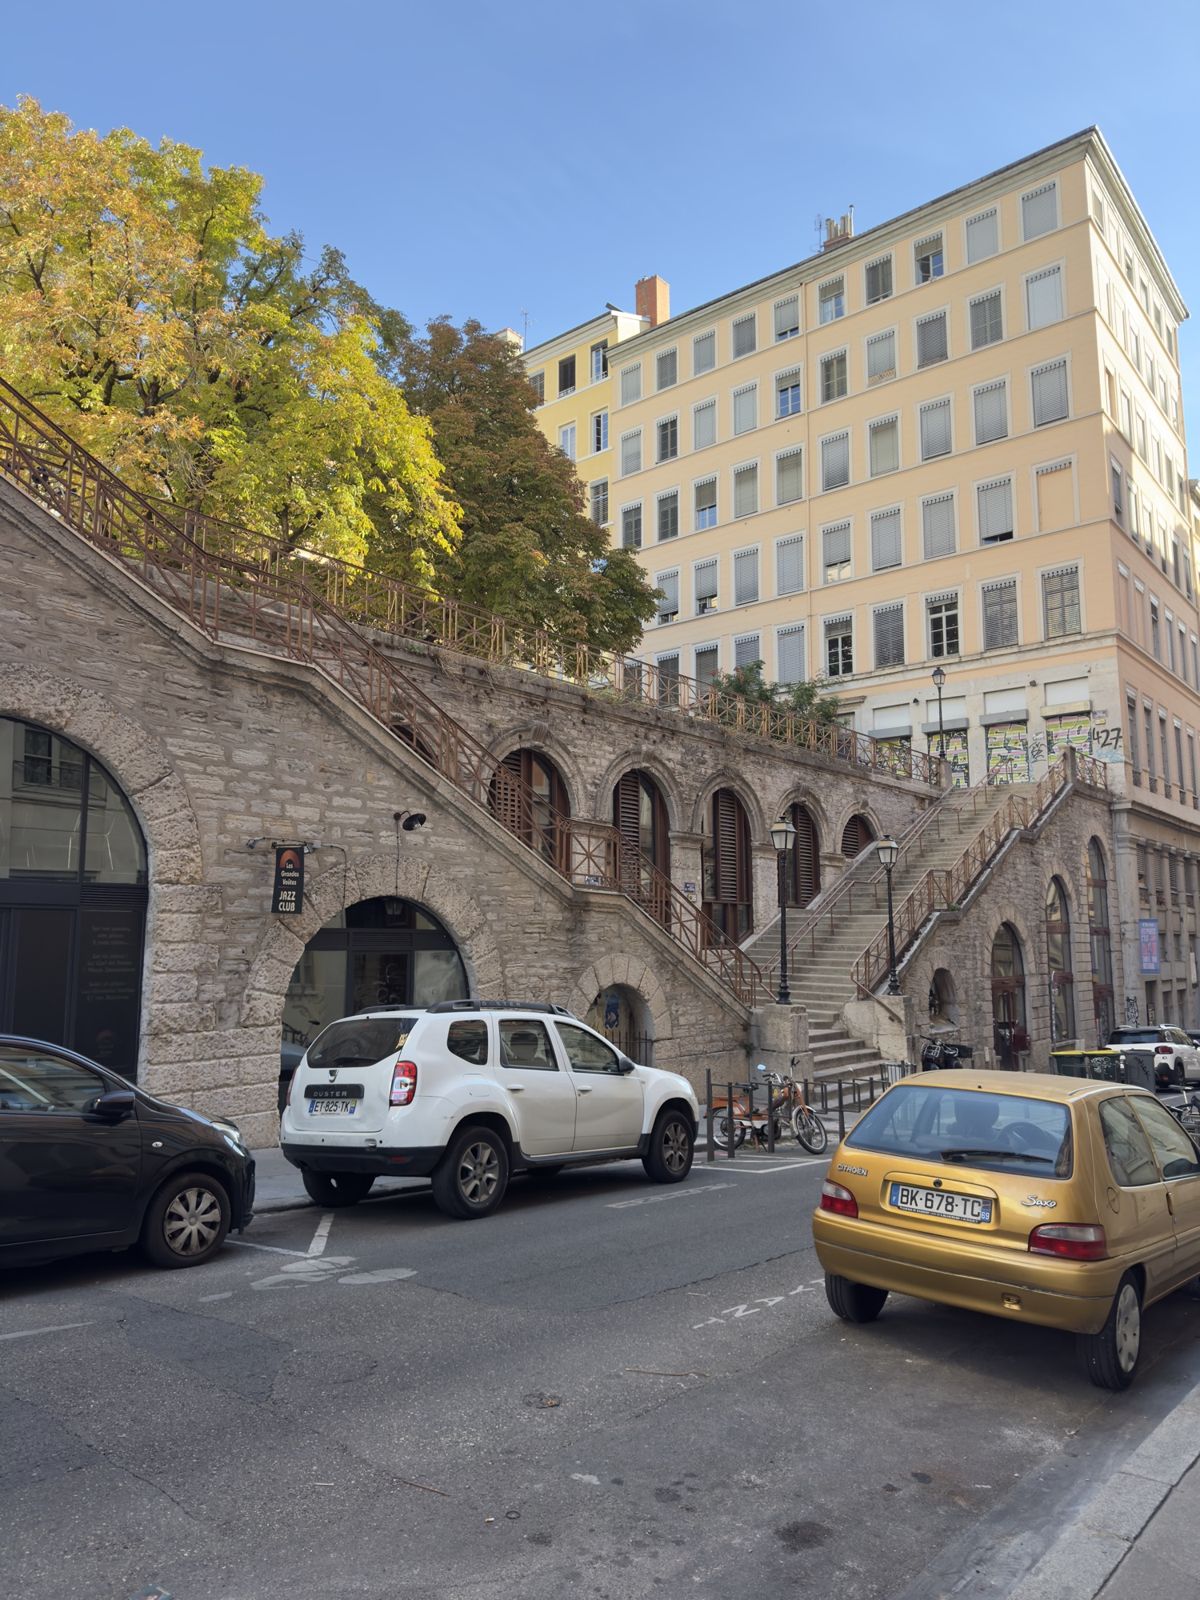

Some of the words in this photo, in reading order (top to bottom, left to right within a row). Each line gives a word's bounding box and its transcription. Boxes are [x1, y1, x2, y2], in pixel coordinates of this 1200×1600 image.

[279, 891, 295, 900] JAZZ
[278, 902, 295, 911] CLUB
[1020, 1194, 1057, 1209] Saxo
[981, 1211, 990, 1220] 69
